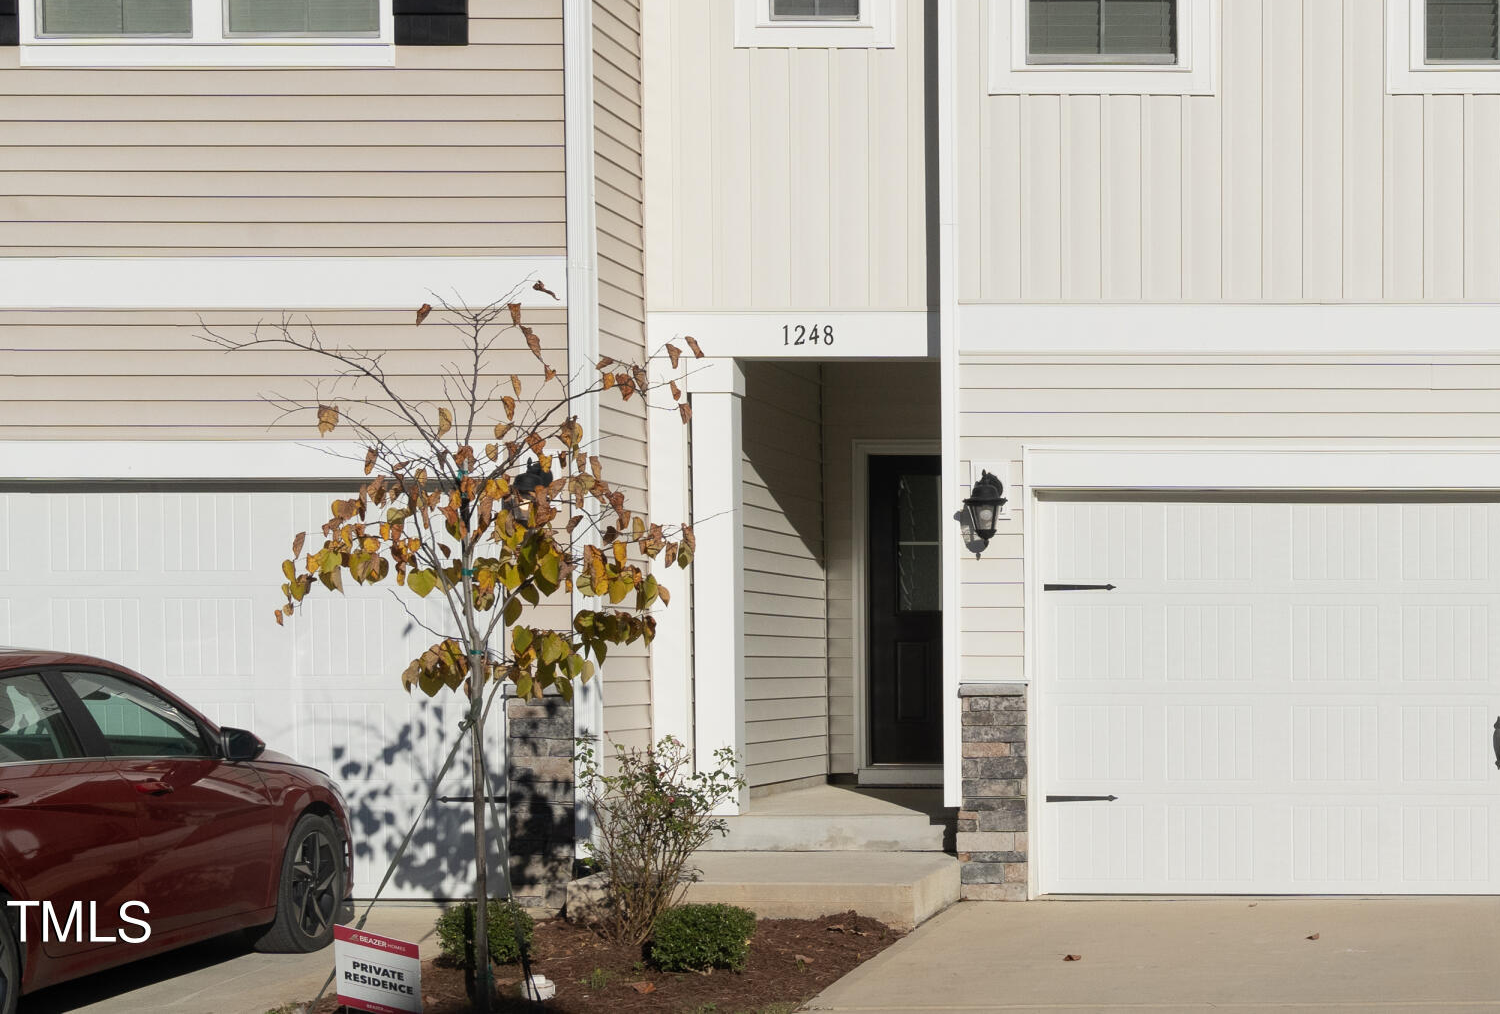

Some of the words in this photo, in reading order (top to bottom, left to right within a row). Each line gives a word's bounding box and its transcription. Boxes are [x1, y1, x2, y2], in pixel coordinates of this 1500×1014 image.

[782, 323, 834, 346] 1248
[359, 935, 387, 948] BEAZER
[352, 961, 404, 982] PRIVATE
[344, 971, 414, 995] RESIDENCE
